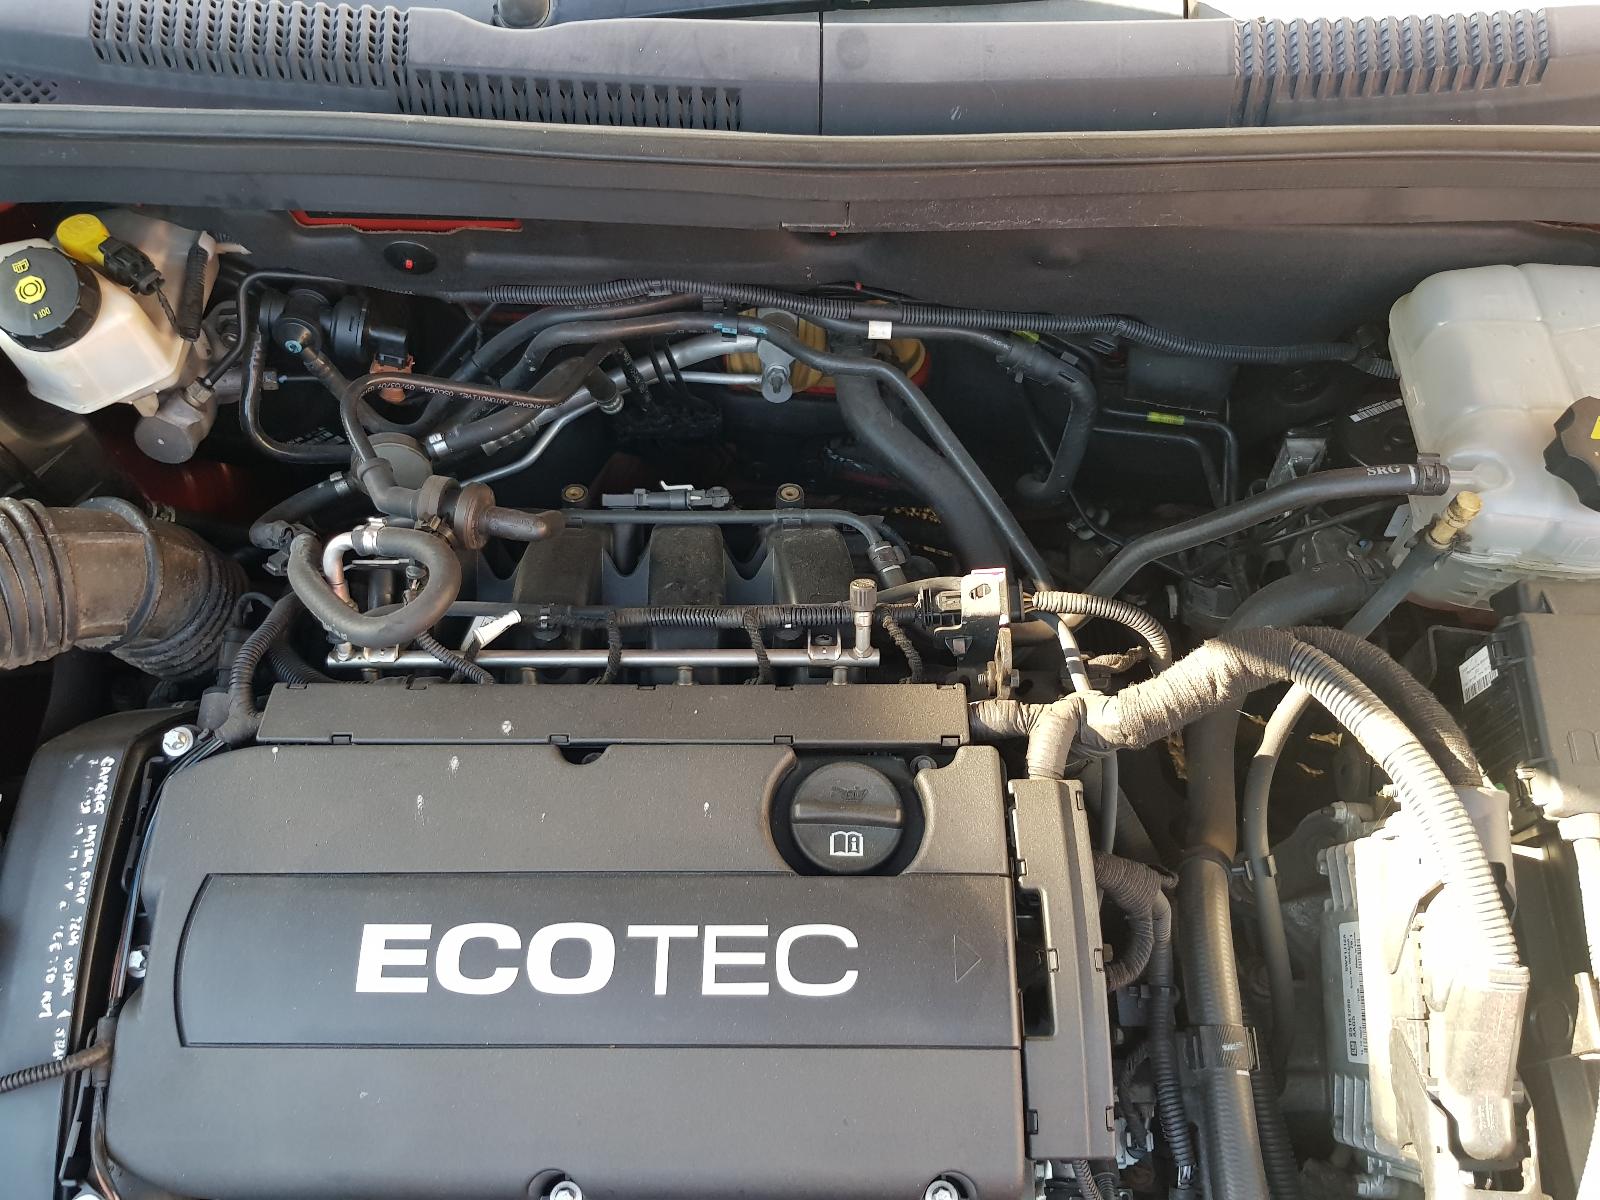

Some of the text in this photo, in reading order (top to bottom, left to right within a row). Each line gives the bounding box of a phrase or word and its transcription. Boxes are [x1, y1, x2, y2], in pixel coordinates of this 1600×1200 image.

[39, 307, 51, 318] DOT
[1366, 464, 1401, 476] SRG
[355, 922, 859, 996] ECOTEC
